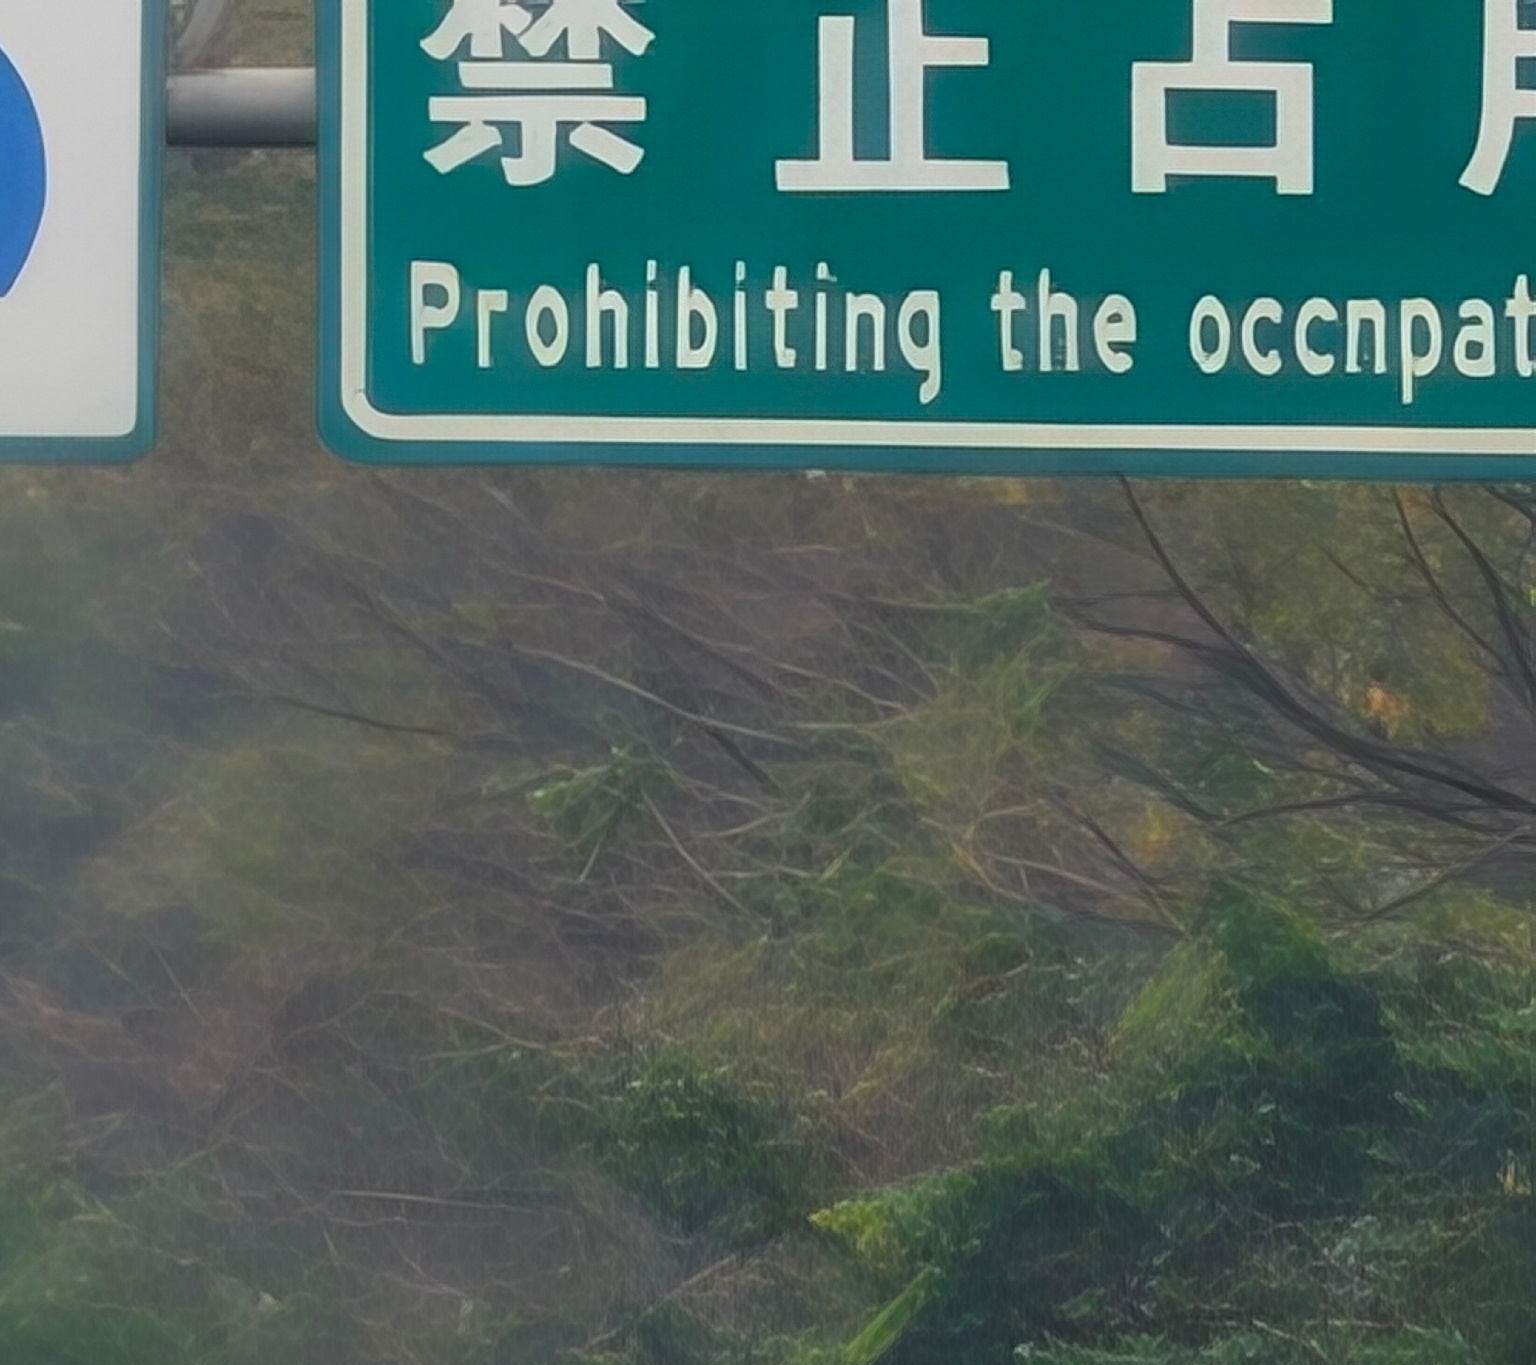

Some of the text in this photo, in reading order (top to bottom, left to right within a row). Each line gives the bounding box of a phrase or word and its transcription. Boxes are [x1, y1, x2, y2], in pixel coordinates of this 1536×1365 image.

[421, 0, 1536, 195] 禁止占
[409, 261, 942, 404] Prohibiting
[990, 267, 1137, 373] the
